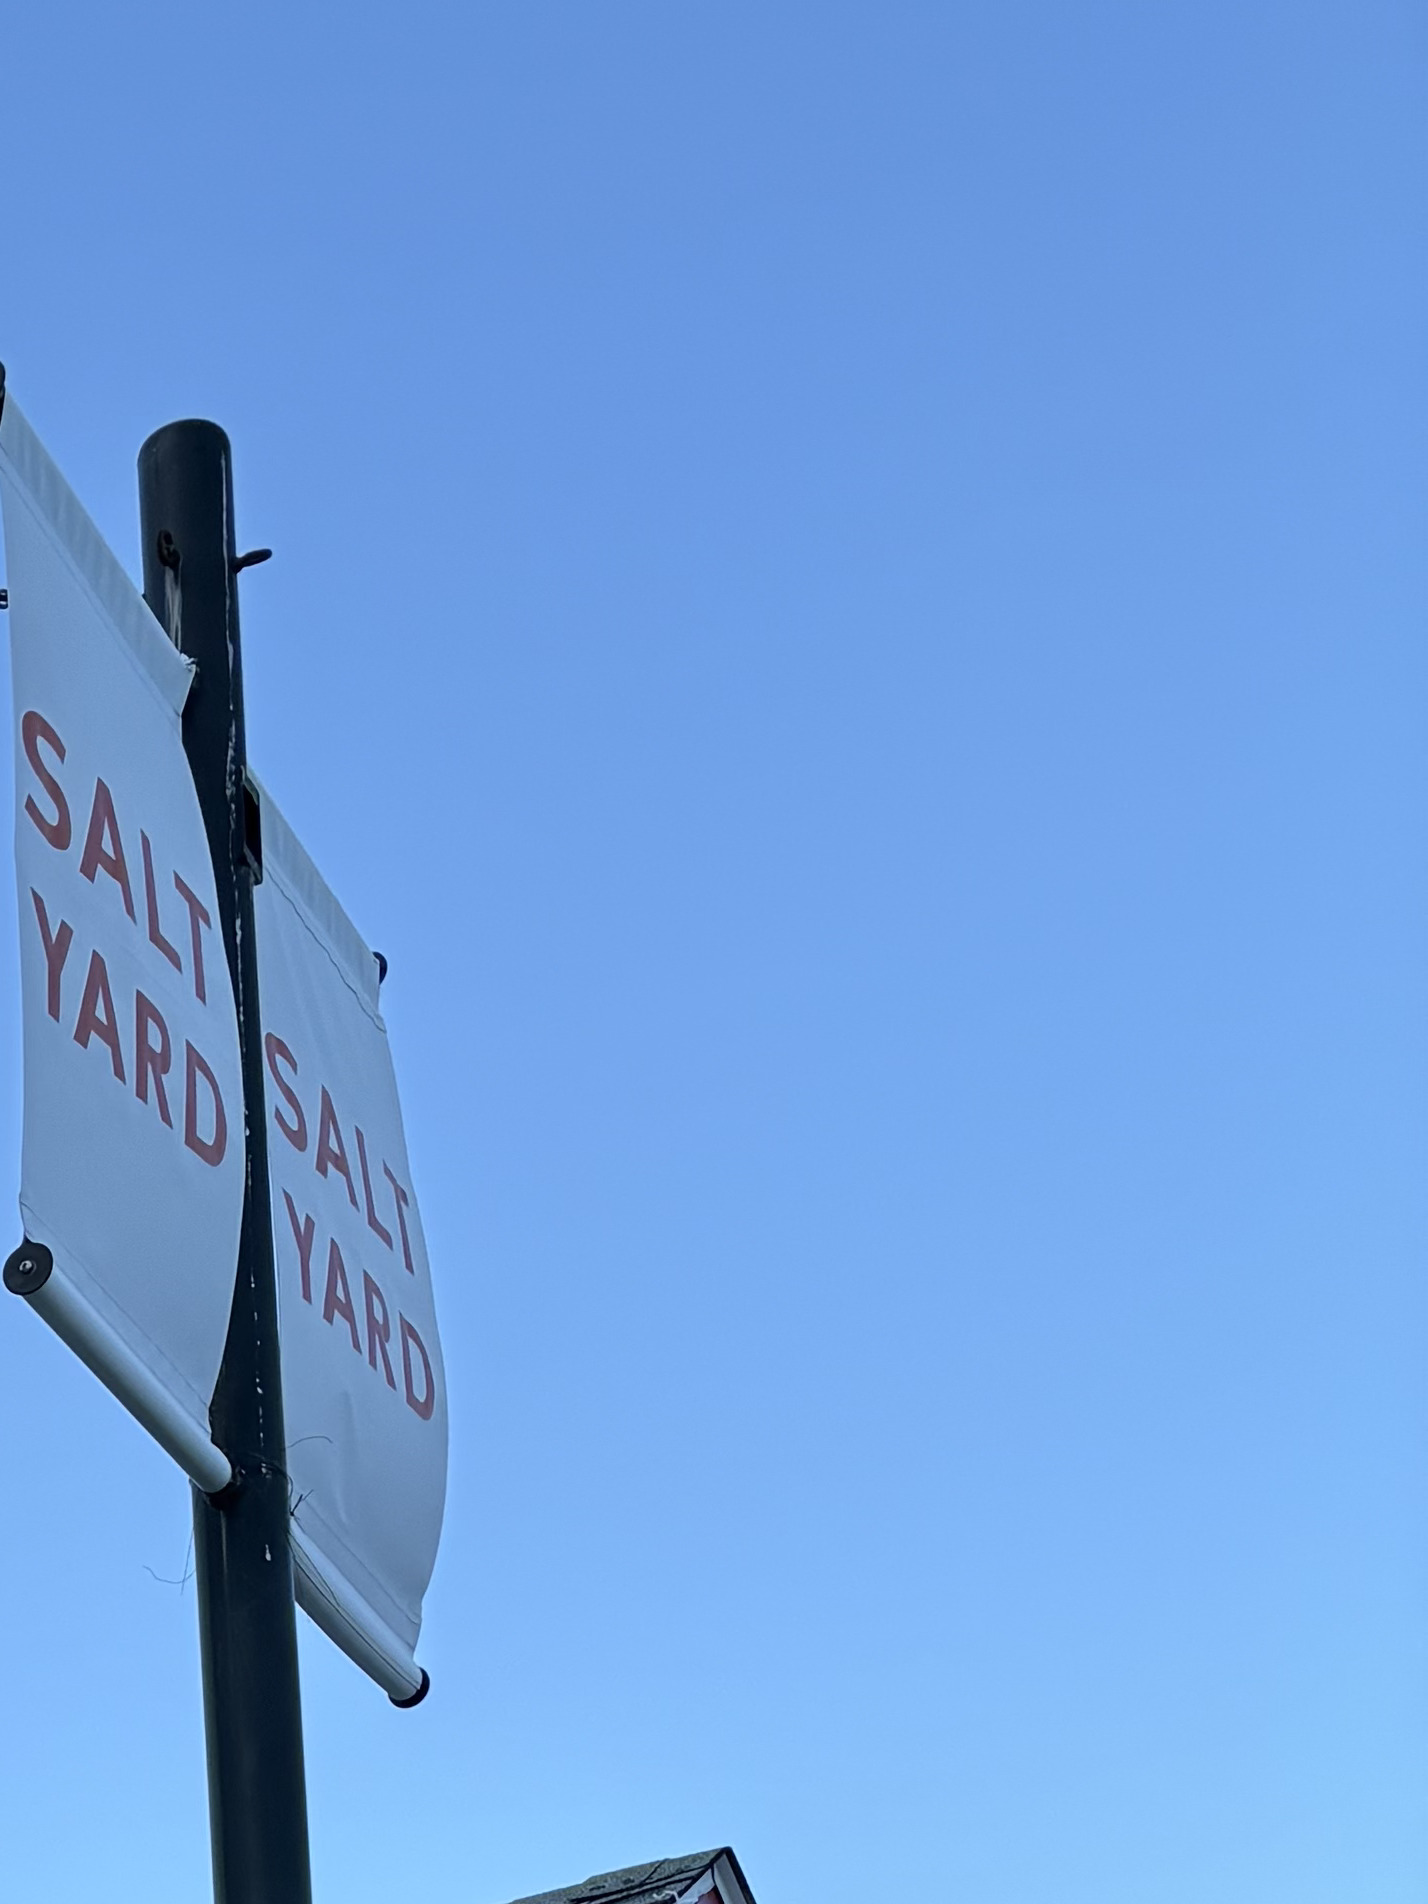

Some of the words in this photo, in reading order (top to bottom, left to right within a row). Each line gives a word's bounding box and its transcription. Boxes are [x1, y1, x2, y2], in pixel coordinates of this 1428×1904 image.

[20, 708, 212, 1008] SALT
[29, 884, 229, 1170] YARD
[262, 1030, 417, 1278] SALT
[281, 1185, 437, 1423] YARD
